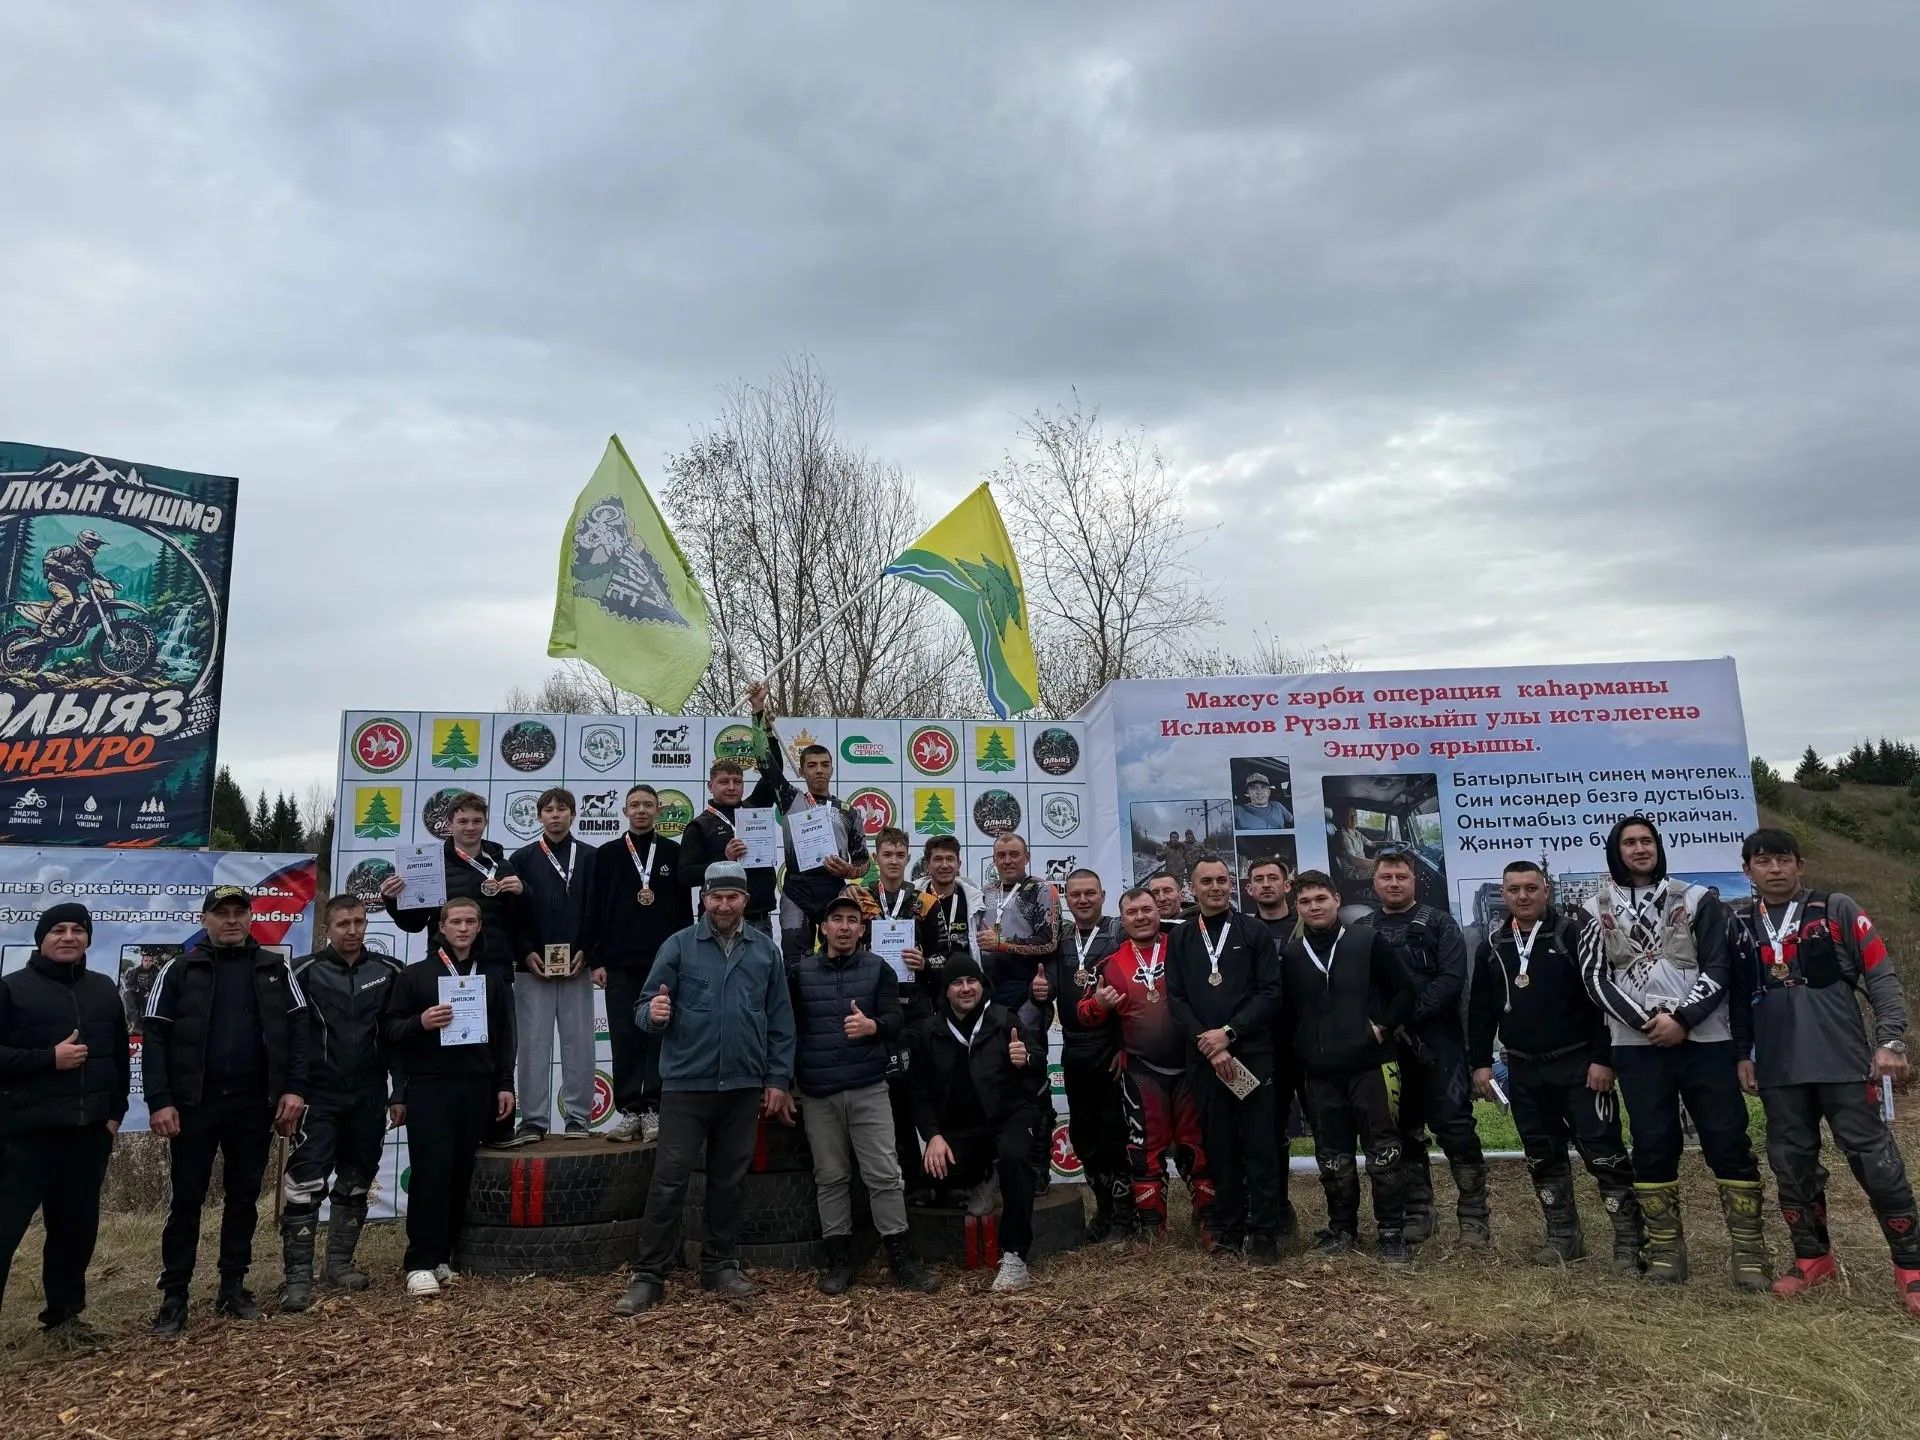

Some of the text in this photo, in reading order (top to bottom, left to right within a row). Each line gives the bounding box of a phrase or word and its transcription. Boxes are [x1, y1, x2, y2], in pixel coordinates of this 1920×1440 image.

[113, 486, 223, 533] ЧИШМӘ
[1186, 680, 1669, 711] Махсус хәрби операция каһарманы
[1161, 706, 1701, 737] Исламов Рүзәл Нәкыйп улы истәлегенә
[1323, 737, 1542, 761] Эндуро ярышы.
[652, 754, 691, 764] ОЛЫЯЗ
[1453, 767, 1750, 788] Батырлыгың синең мәңгелек...
[1455, 785, 1745, 808] Син исәндер безгә дустыбыз.
[9, 817, 42, 825] ДВИЖЕНИЕ
[75, 813, 103, 821] САЛКЫН
[579, 820, 620, 831] ОЛЫЯЗ
[1457, 811, 1577, 829] Онытмабыз
[1582, 812, 1627, 825] сине
[1459, 835, 1533, 853] Җәннәт
[1539, 834, 1583, 851] түре
[406, 862, 433, 870] ДИПЛОМ
[49, 880, 161, 897] беркайчан
[165, 883, 294, 897] онытмас...
[0, 907, 43, 924] булс
[88, 909, 203, 924] вылдаш-гер
